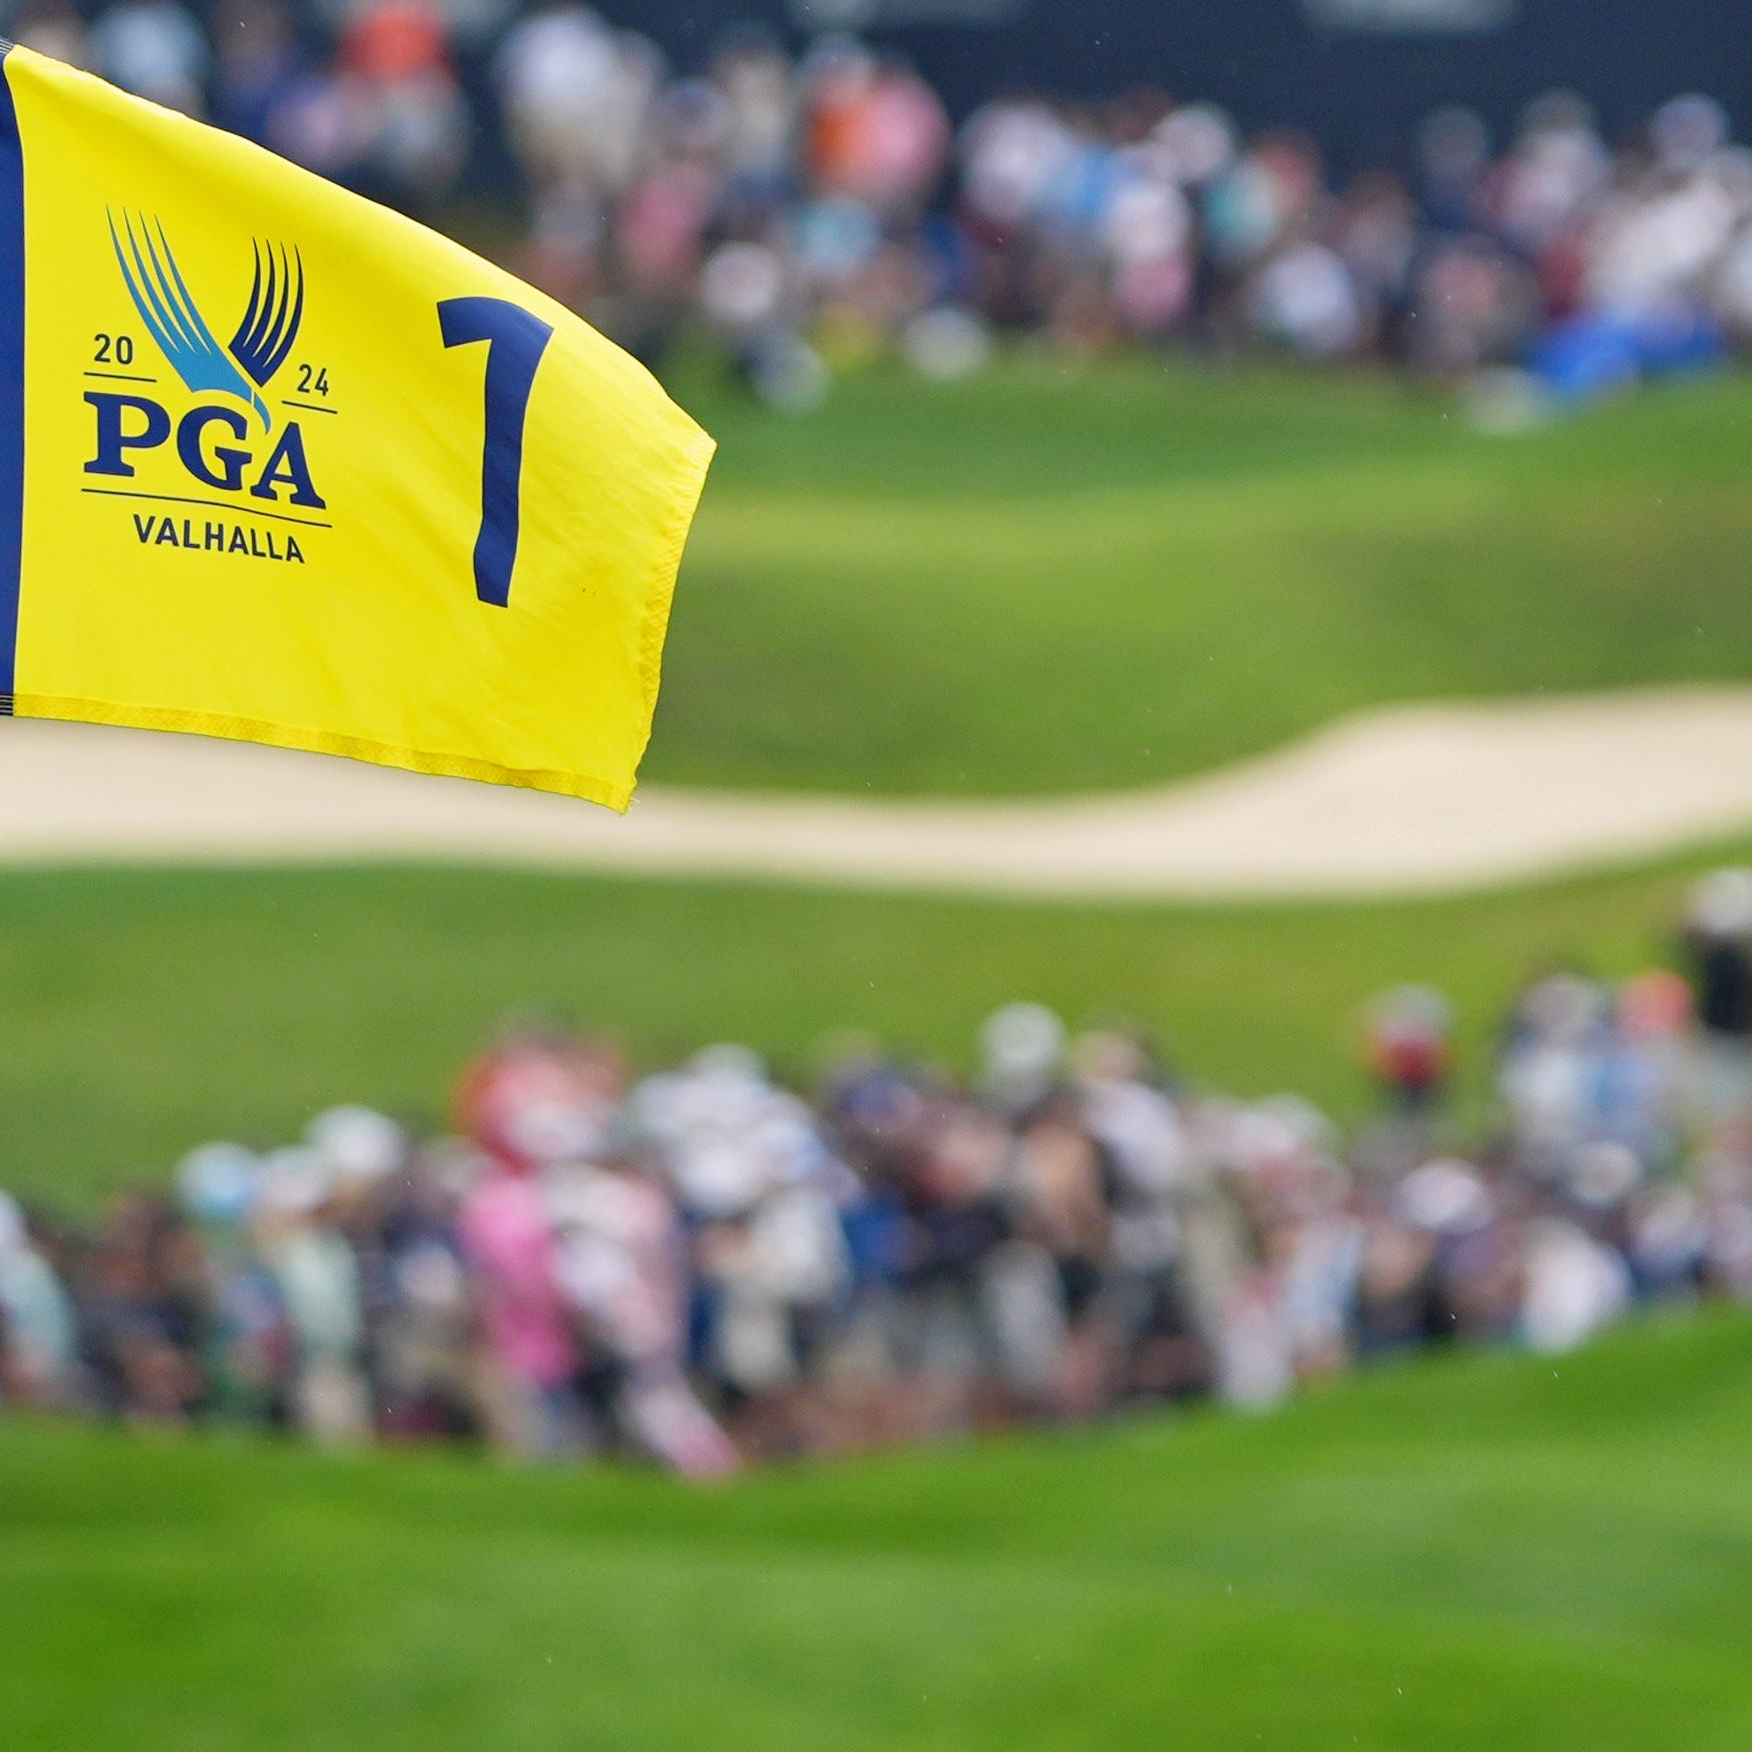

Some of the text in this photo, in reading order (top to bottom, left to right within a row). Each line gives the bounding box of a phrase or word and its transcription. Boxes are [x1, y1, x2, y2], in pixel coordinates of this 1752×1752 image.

[92, 333, 134, 365] 20
[296, 363, 330, 398] 24
[83, 391, 327, 510] PGA
[436, 296, 554, 609] 1
[133, 513, 306, 565] VALHALLA
